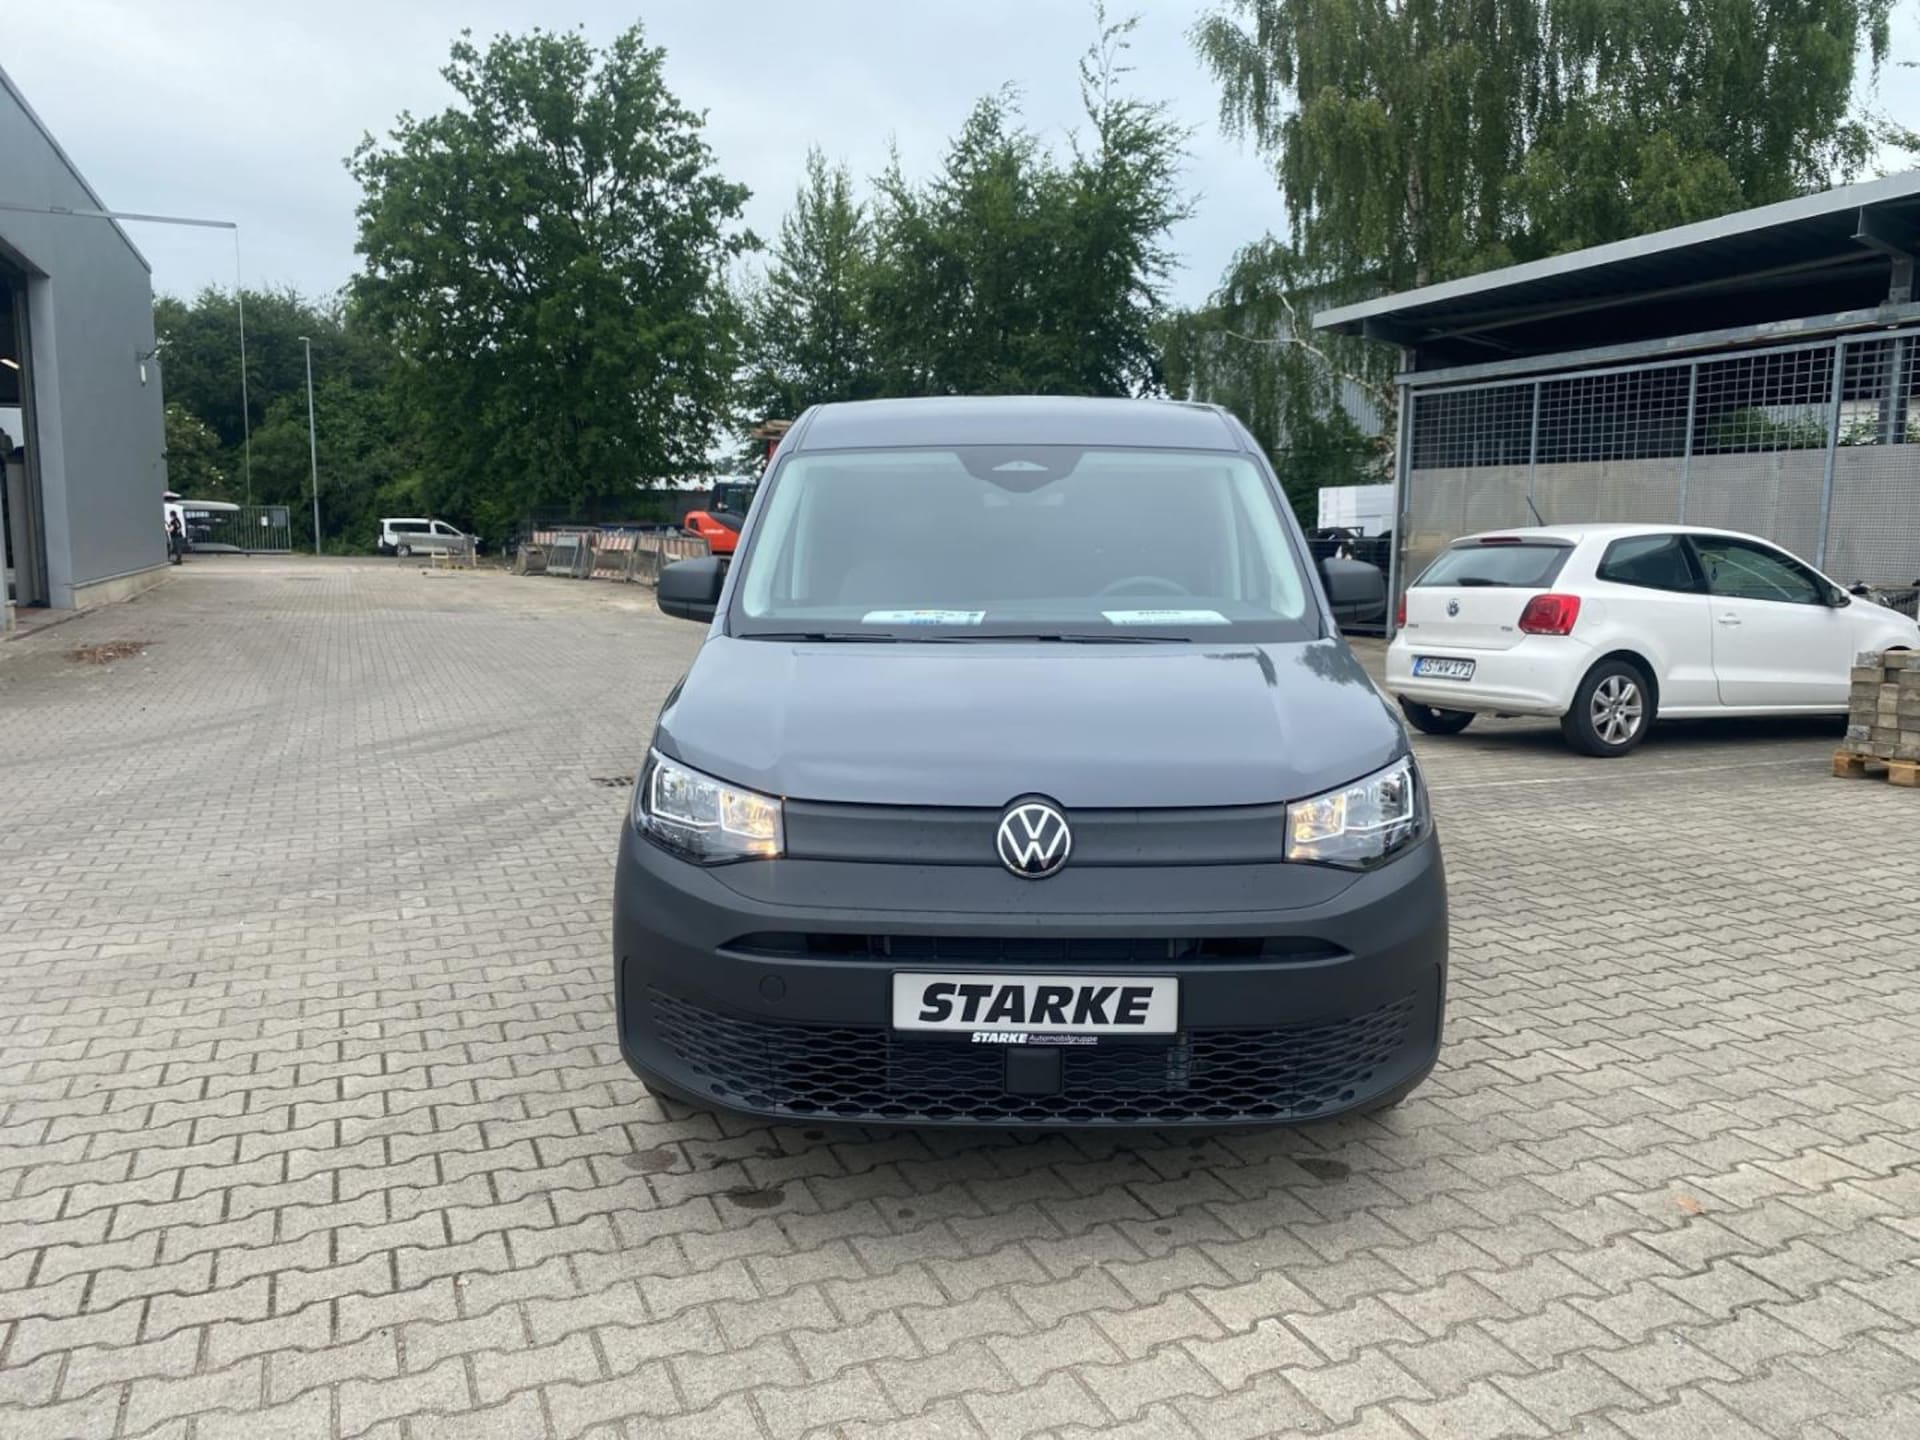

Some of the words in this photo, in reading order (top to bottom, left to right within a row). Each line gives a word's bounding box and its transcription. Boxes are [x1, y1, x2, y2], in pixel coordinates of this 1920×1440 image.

[1451, 662, 1472, 676] 171
[1001, 806, 1067, 870] VW
[918, 982, 1154, 1025] STARKE
[971, 1031, 1028, 1044] STARKE
